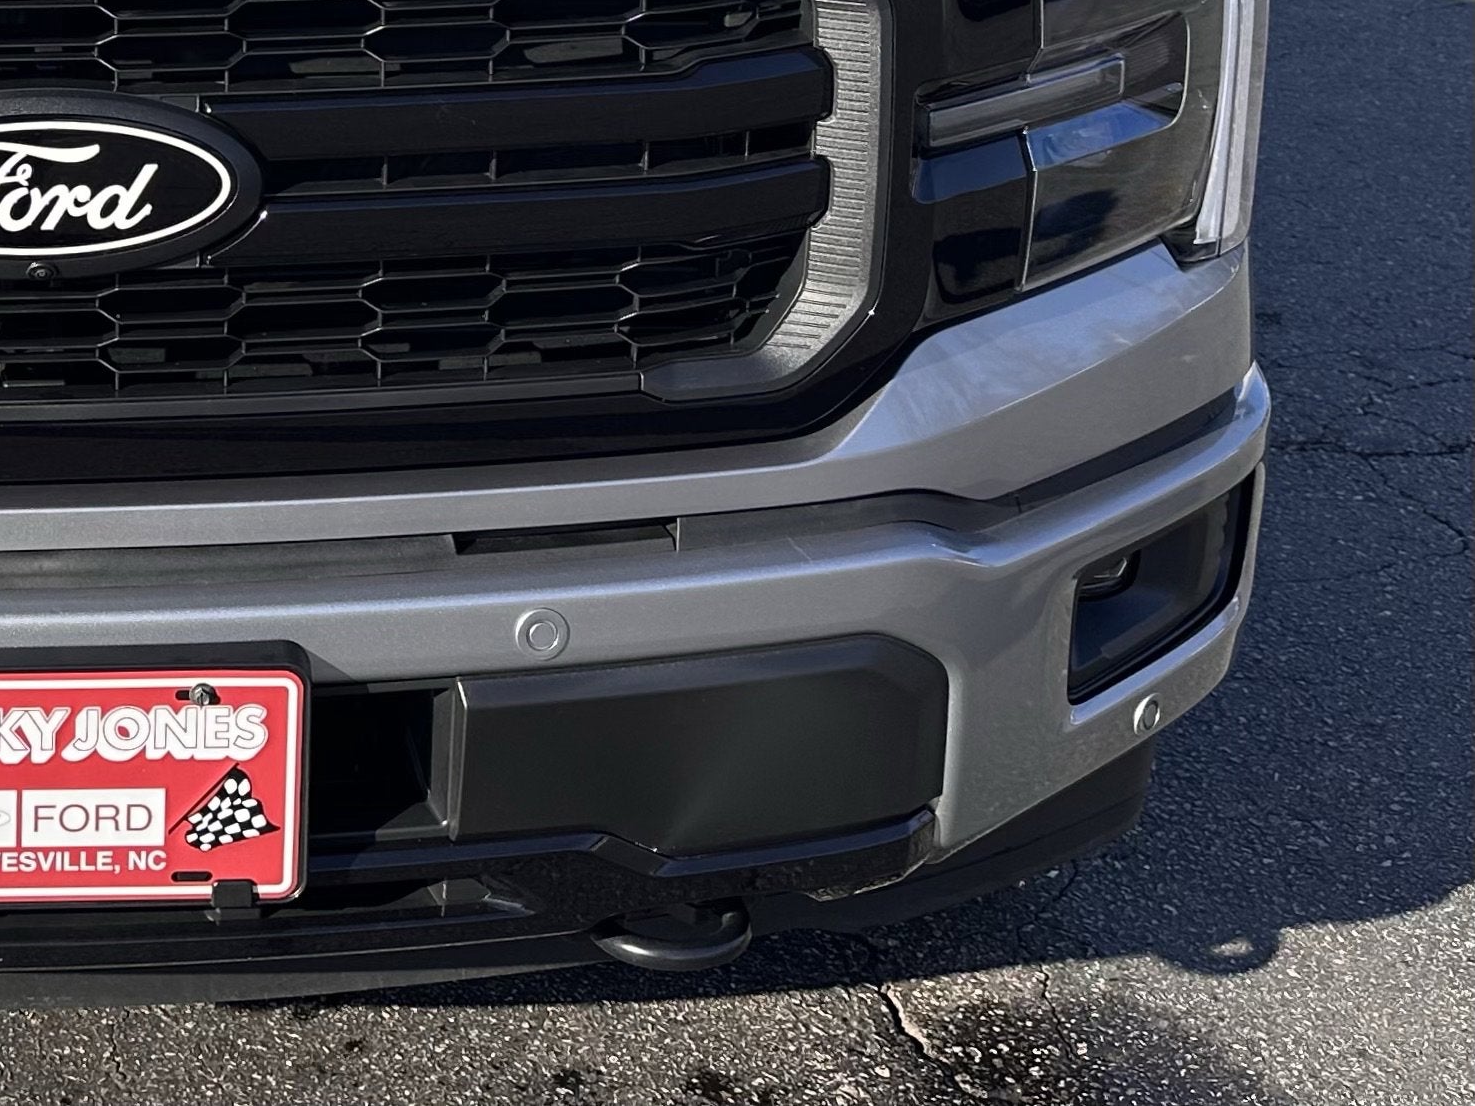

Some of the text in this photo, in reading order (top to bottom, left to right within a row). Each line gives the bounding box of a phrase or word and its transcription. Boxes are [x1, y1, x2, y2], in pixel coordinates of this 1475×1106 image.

[61, 703, 268, 762] JONES
[33, 804, 153, 832] FORD
[128, 850, 167, 871] NC
